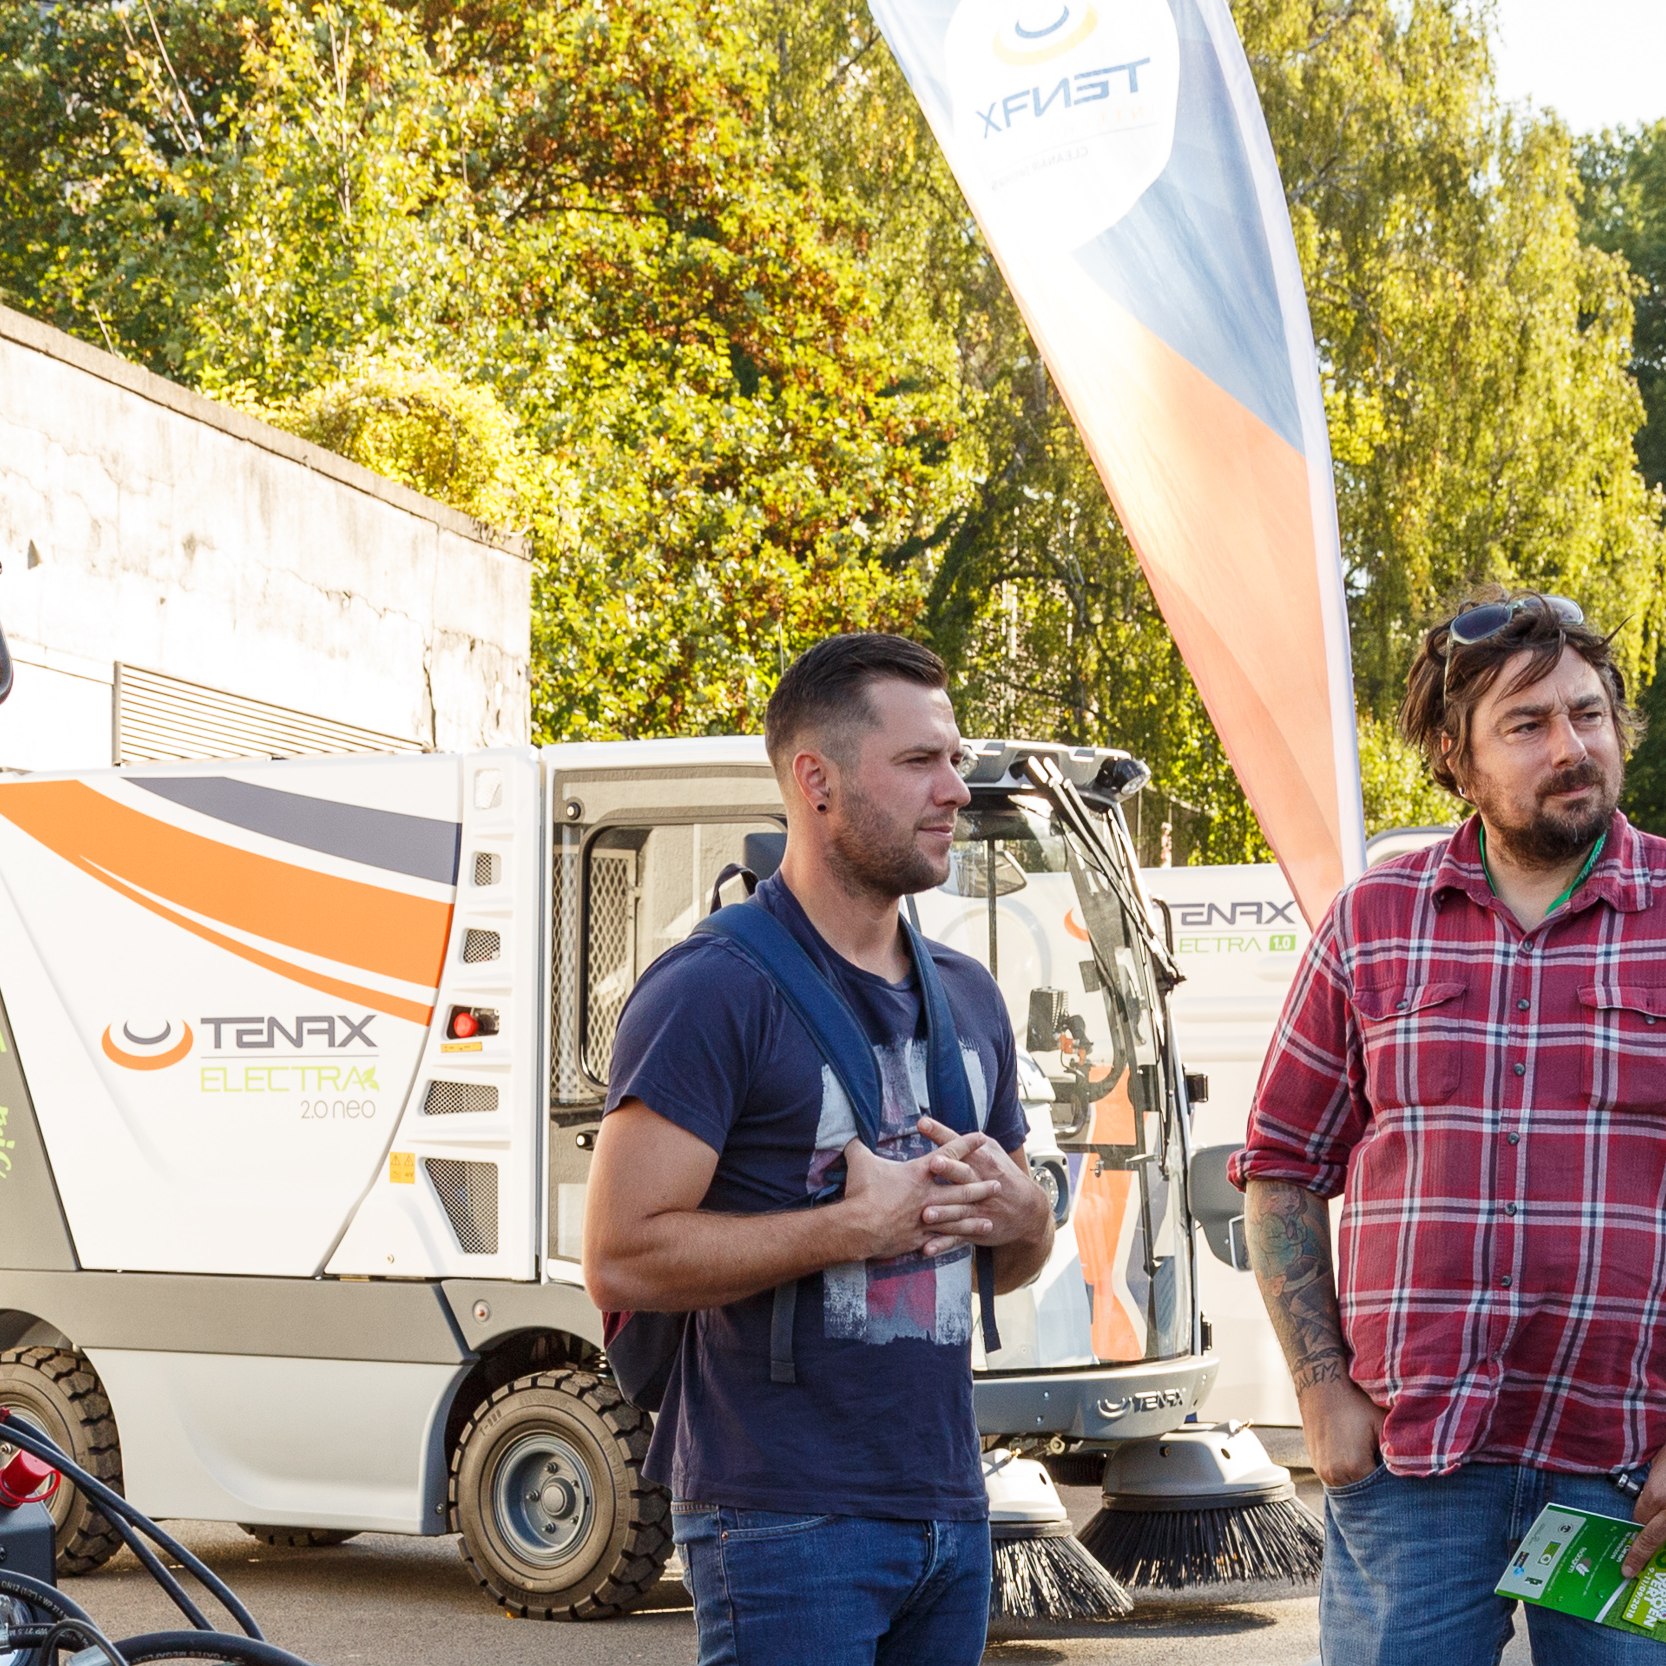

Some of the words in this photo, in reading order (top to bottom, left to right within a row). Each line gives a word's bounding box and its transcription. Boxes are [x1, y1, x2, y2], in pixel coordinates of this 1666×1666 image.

[1161, 937, 1262, 953] ECTRA
[1273, 938, 1290, 949] 1.0
[200, 1014, 378, 1049] TENAX
[200, 1065, 369, 1093] ELECTRA
[300, 1100, 328, 1119] 2.0
[332, 1099, 376, 1119] neo
[1131, 1389, 1184, 1413] TENAX
[1643, 1572, 1666, 1602] VERT
